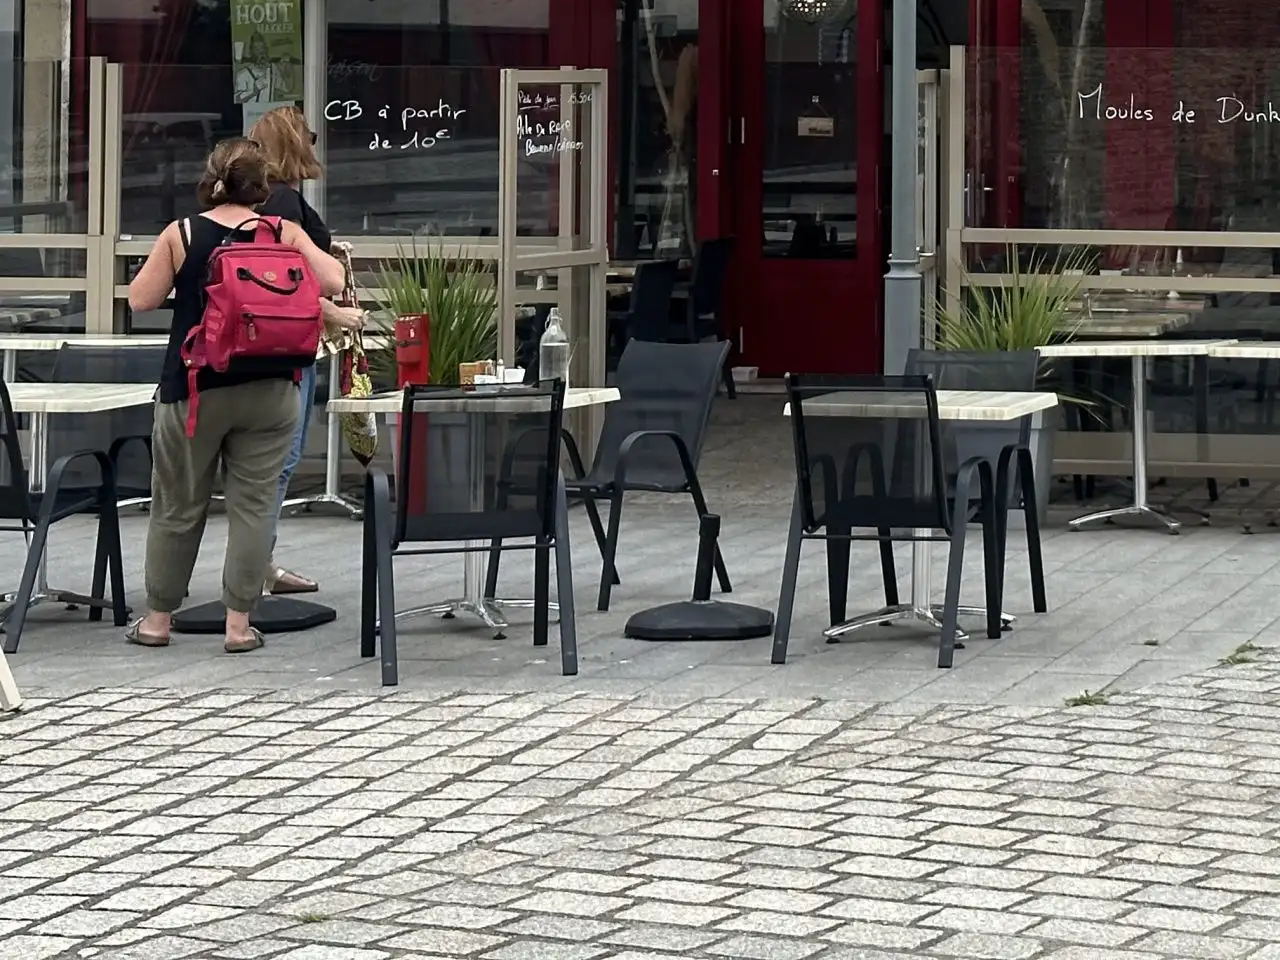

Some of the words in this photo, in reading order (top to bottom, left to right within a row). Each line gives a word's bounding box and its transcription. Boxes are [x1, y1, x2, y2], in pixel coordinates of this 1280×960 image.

[236, 2, 295, 25] HOUT
[323, 100, 363, 121] CB
[378, 104, 391, 120] à
[401, 98, 467, 130] partir
[1077, 83, 1154, 121] Moules
[1171, 100, 1196, 123] de
[368, 133, 393, 150] de
[400, 128, 451, 150] 10€
